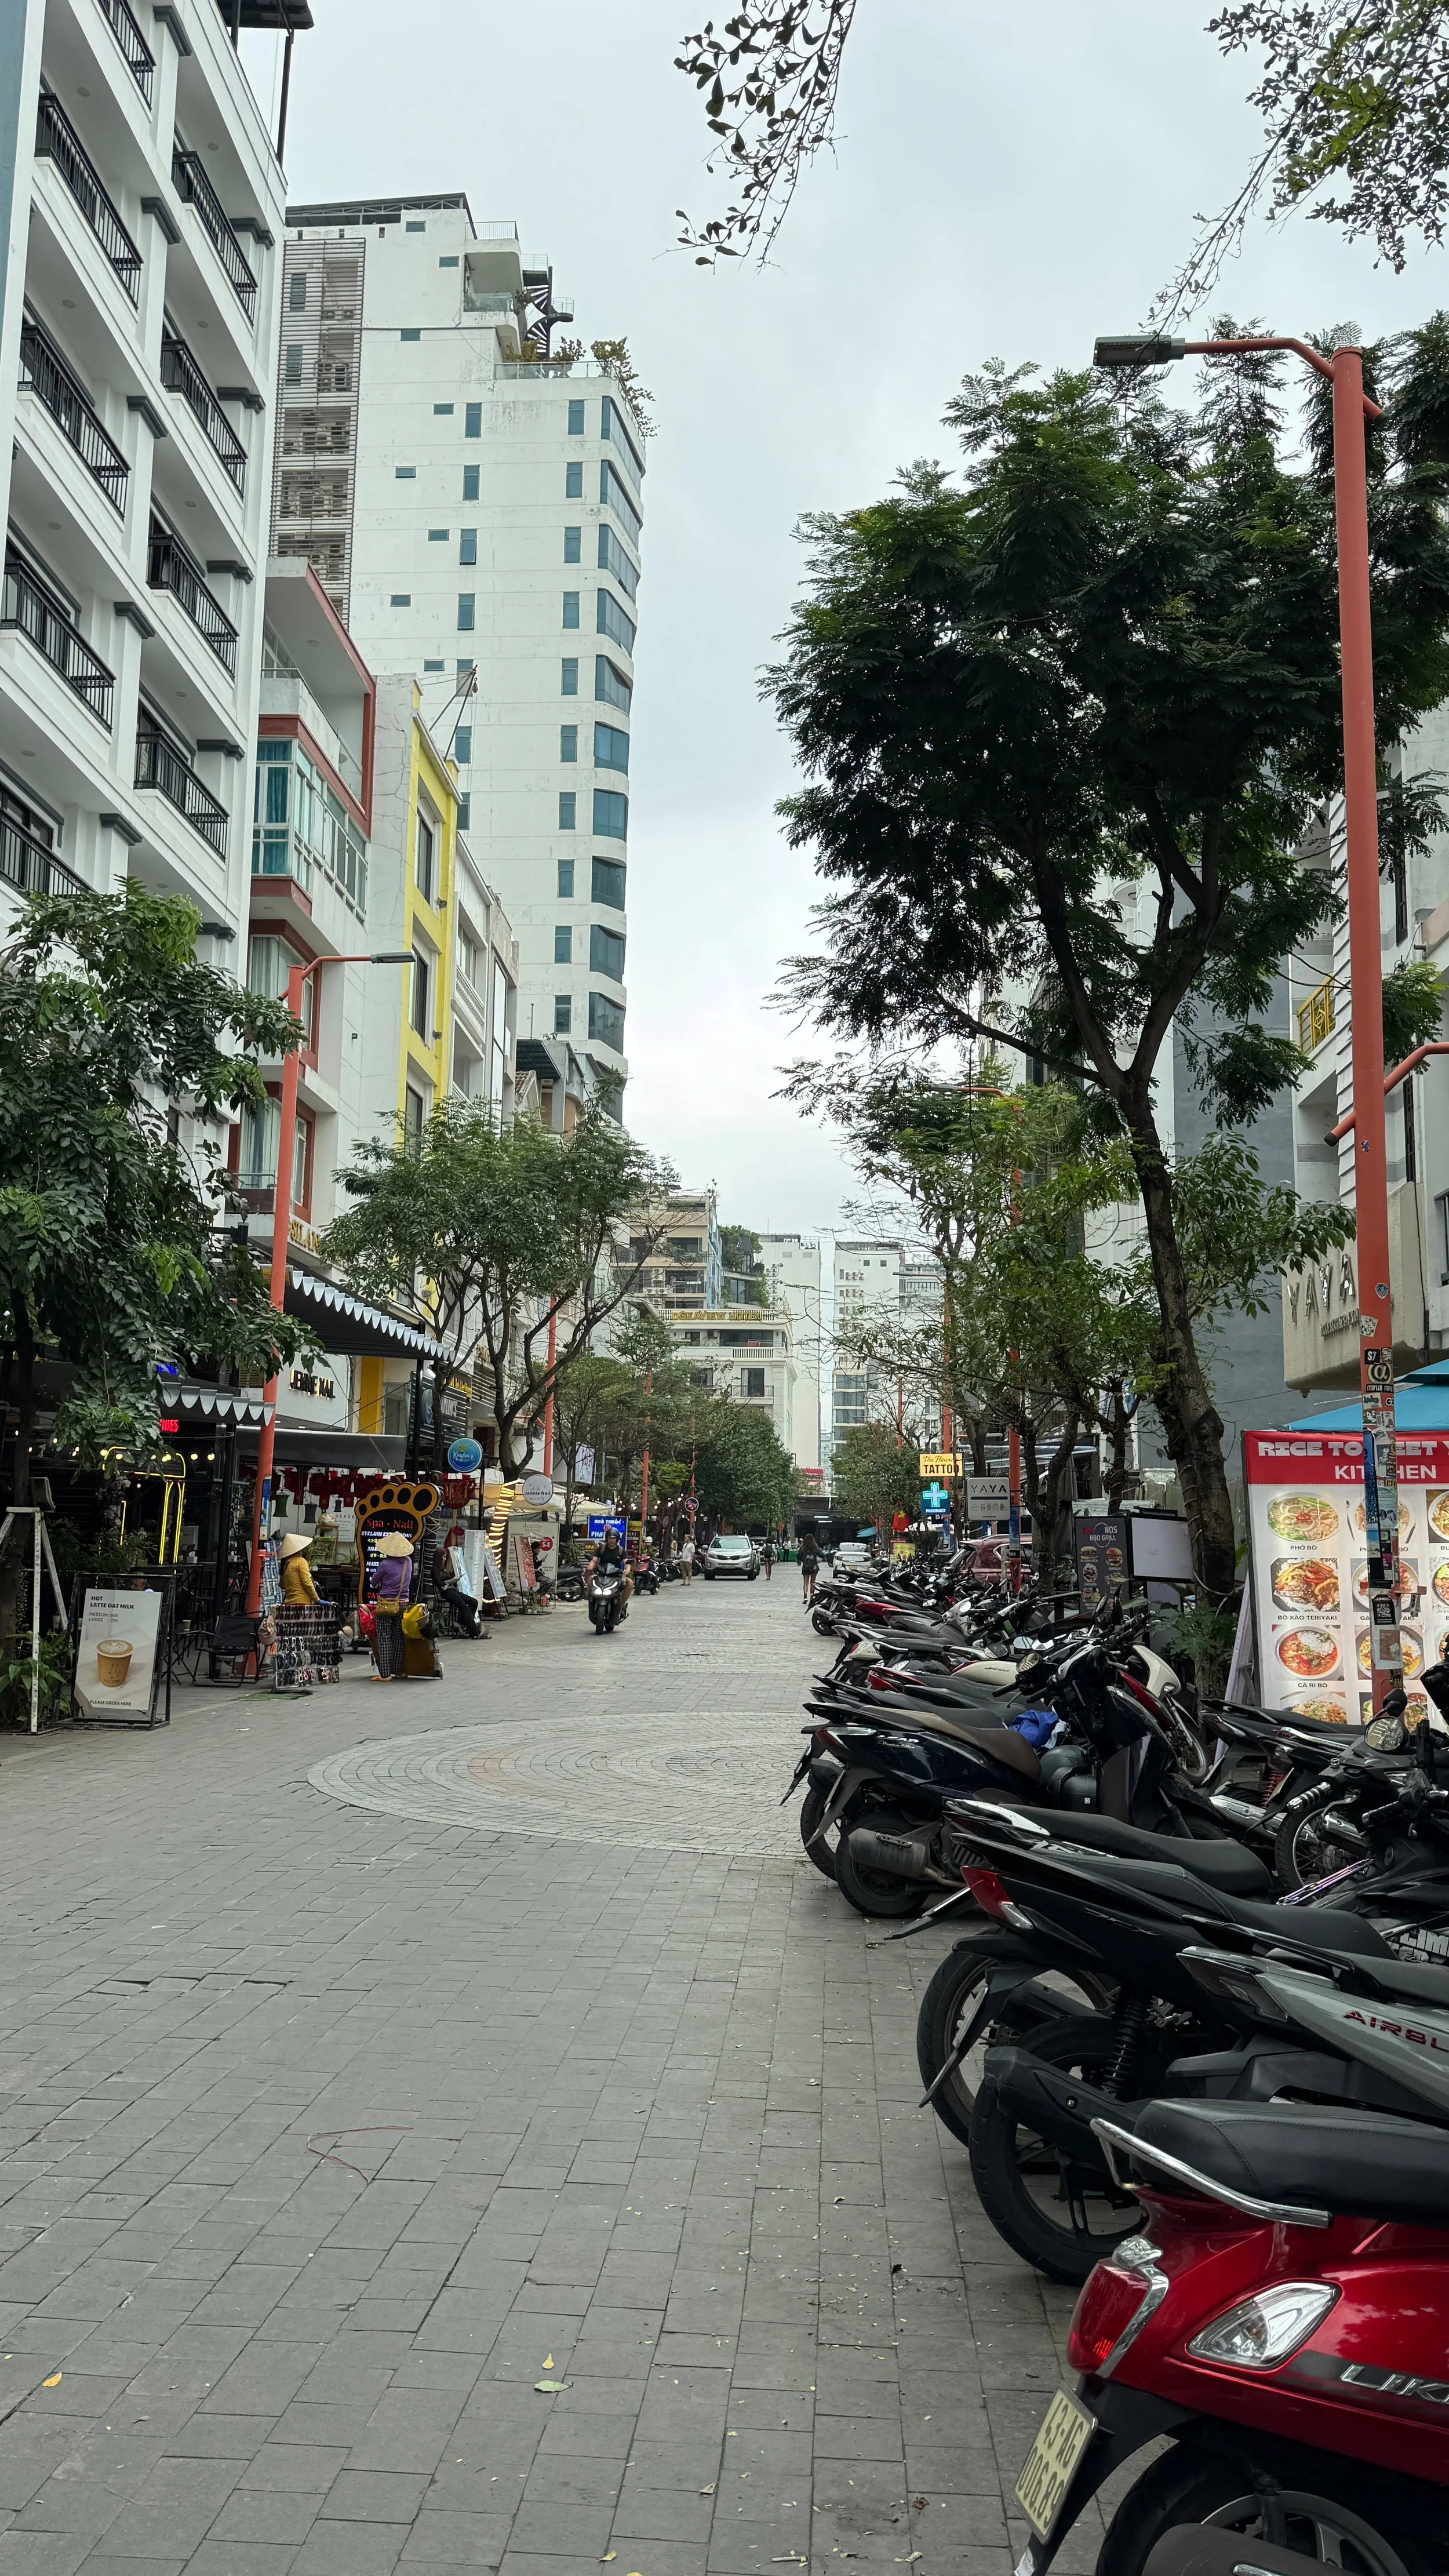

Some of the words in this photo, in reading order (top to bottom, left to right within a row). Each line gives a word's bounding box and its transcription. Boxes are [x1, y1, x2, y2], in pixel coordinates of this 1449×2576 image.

[1287, 1254, 1355, 1323] YAYA
[1367, 1351, 1377, 1361] S7
[1258, 1441, 1323, 1457] RICE
[1328, 1441, 1363, 1457] TO
[1395, 1440, 1438, 1456] EET
[1335, 1464, 1437, 1479] KITHEN
[971, 1485, 1007, 1493] YAYA
[366, 1518, 384, 1529] Spa
[393, 1519, 413, 1529] Nail
[1017, 2445, 1065, 2529] 006.89
